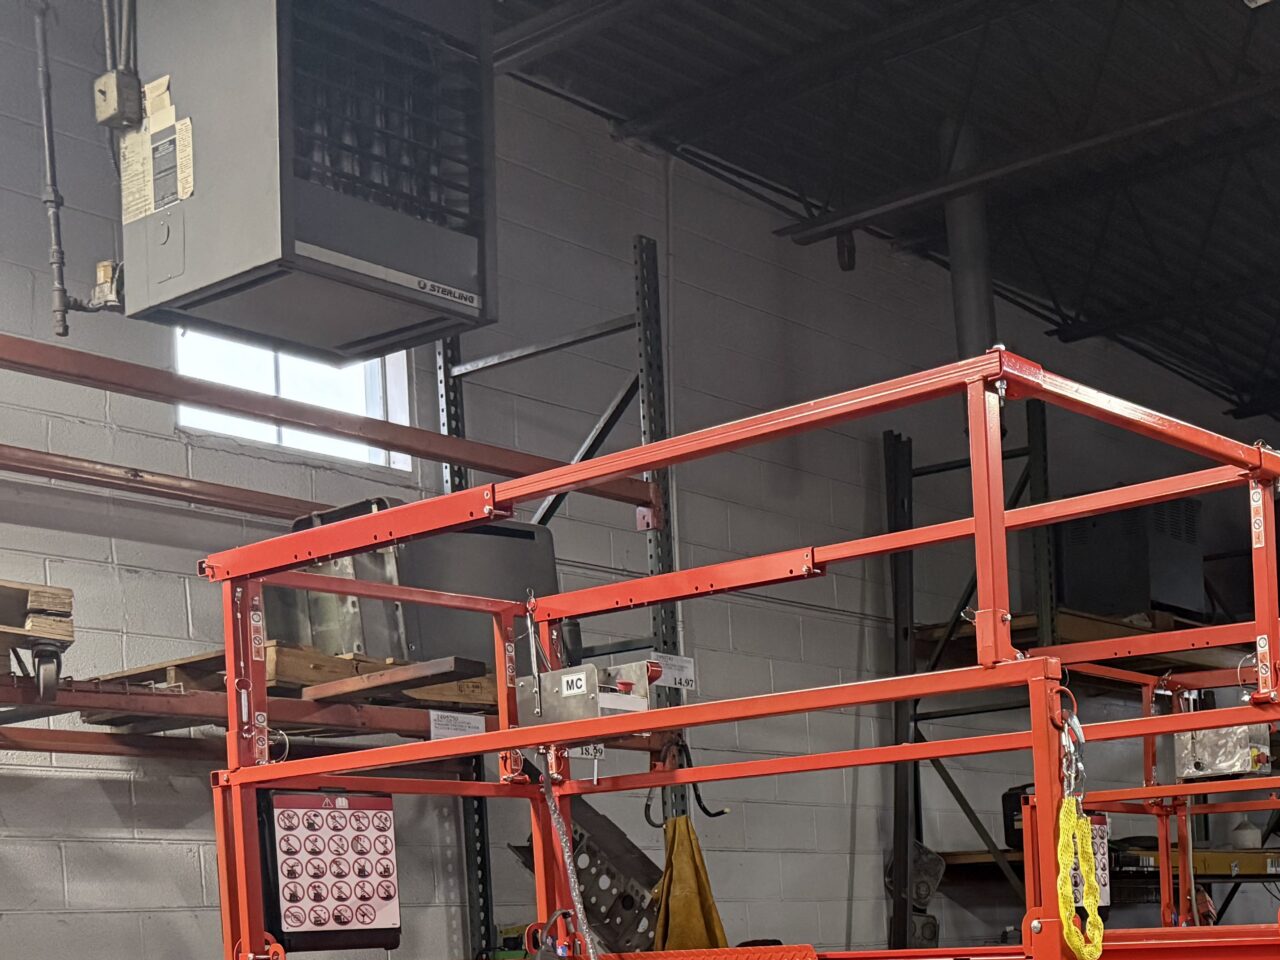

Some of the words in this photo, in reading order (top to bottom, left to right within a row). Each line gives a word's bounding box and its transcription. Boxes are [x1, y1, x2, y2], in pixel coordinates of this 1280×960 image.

[429, 283, 475, 304] STERLING
[566, 677, 583, 691] MC
[674, 677, 694, 688] 14.97
